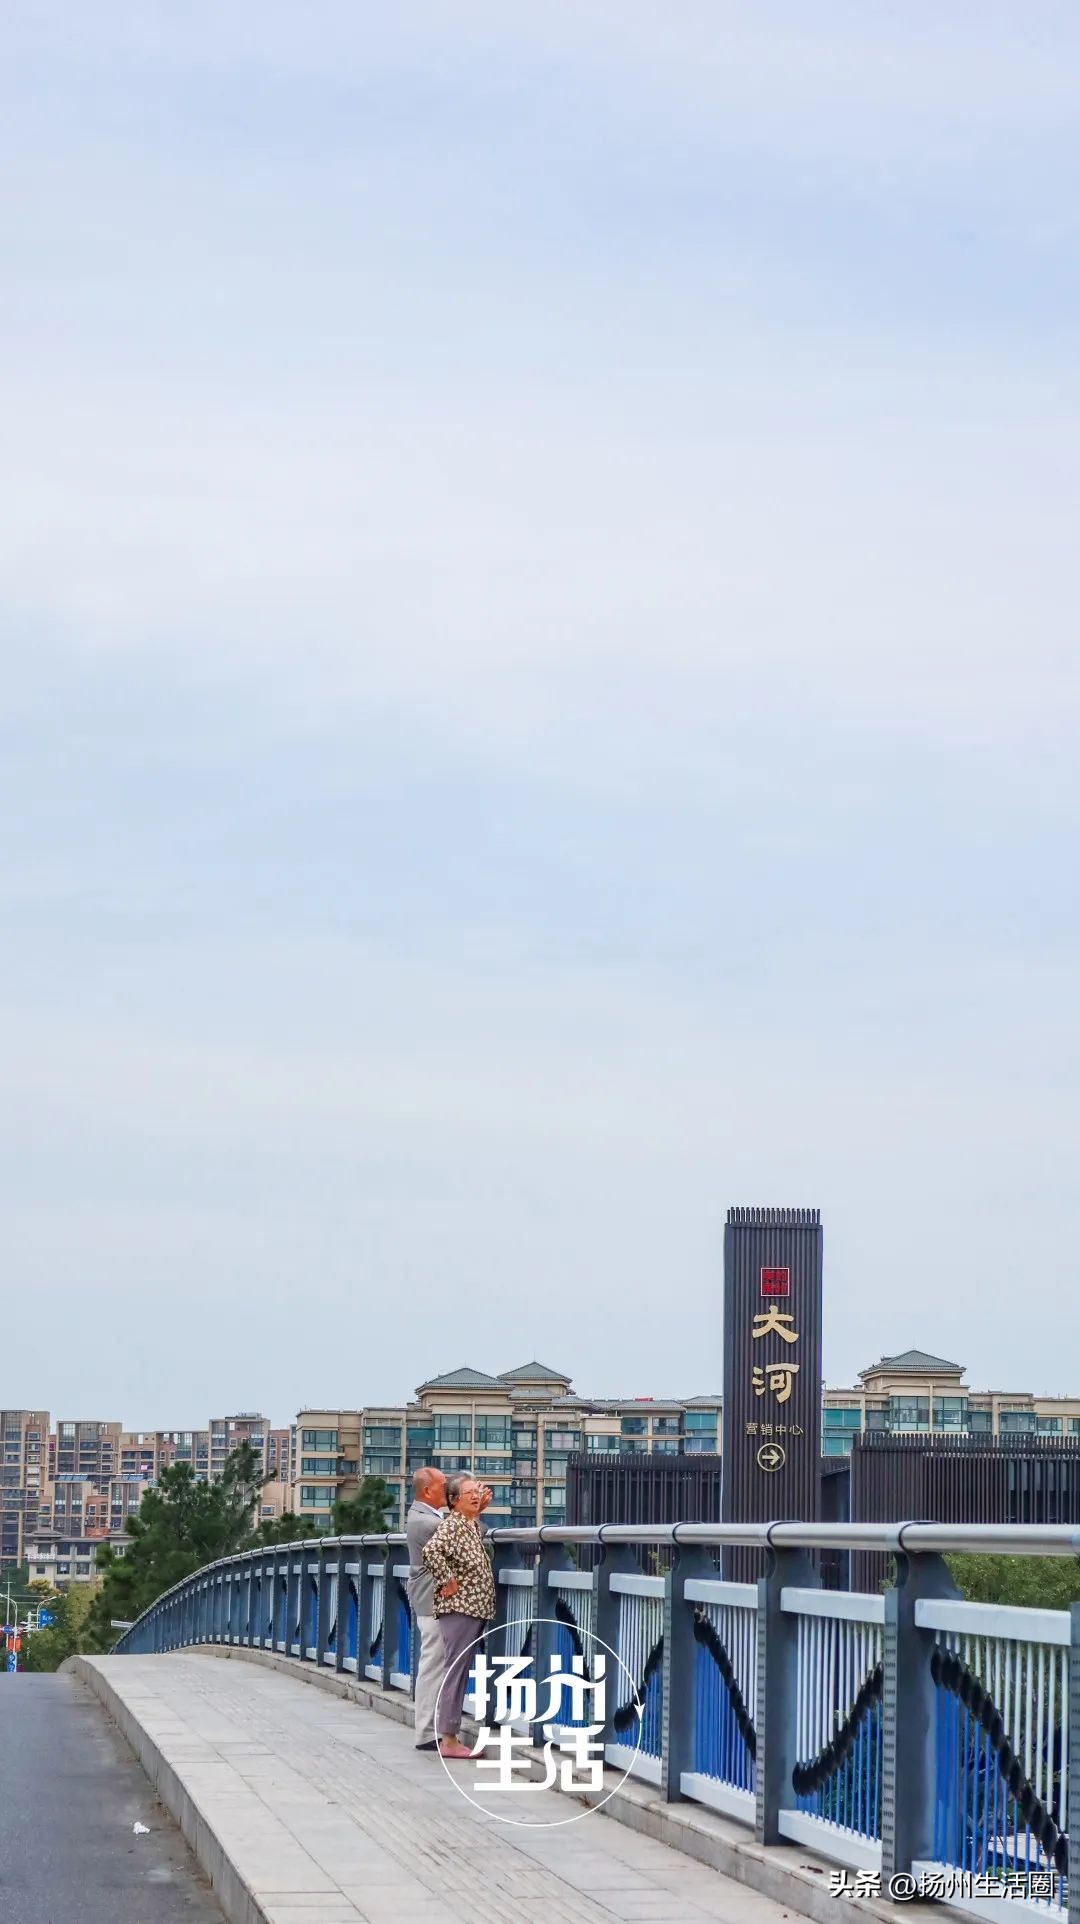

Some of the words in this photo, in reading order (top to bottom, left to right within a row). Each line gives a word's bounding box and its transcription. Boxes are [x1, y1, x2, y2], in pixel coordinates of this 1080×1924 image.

[752, 1305, 800, 1404] 大河
[745, 1422, 804, 1436] 营销中心
